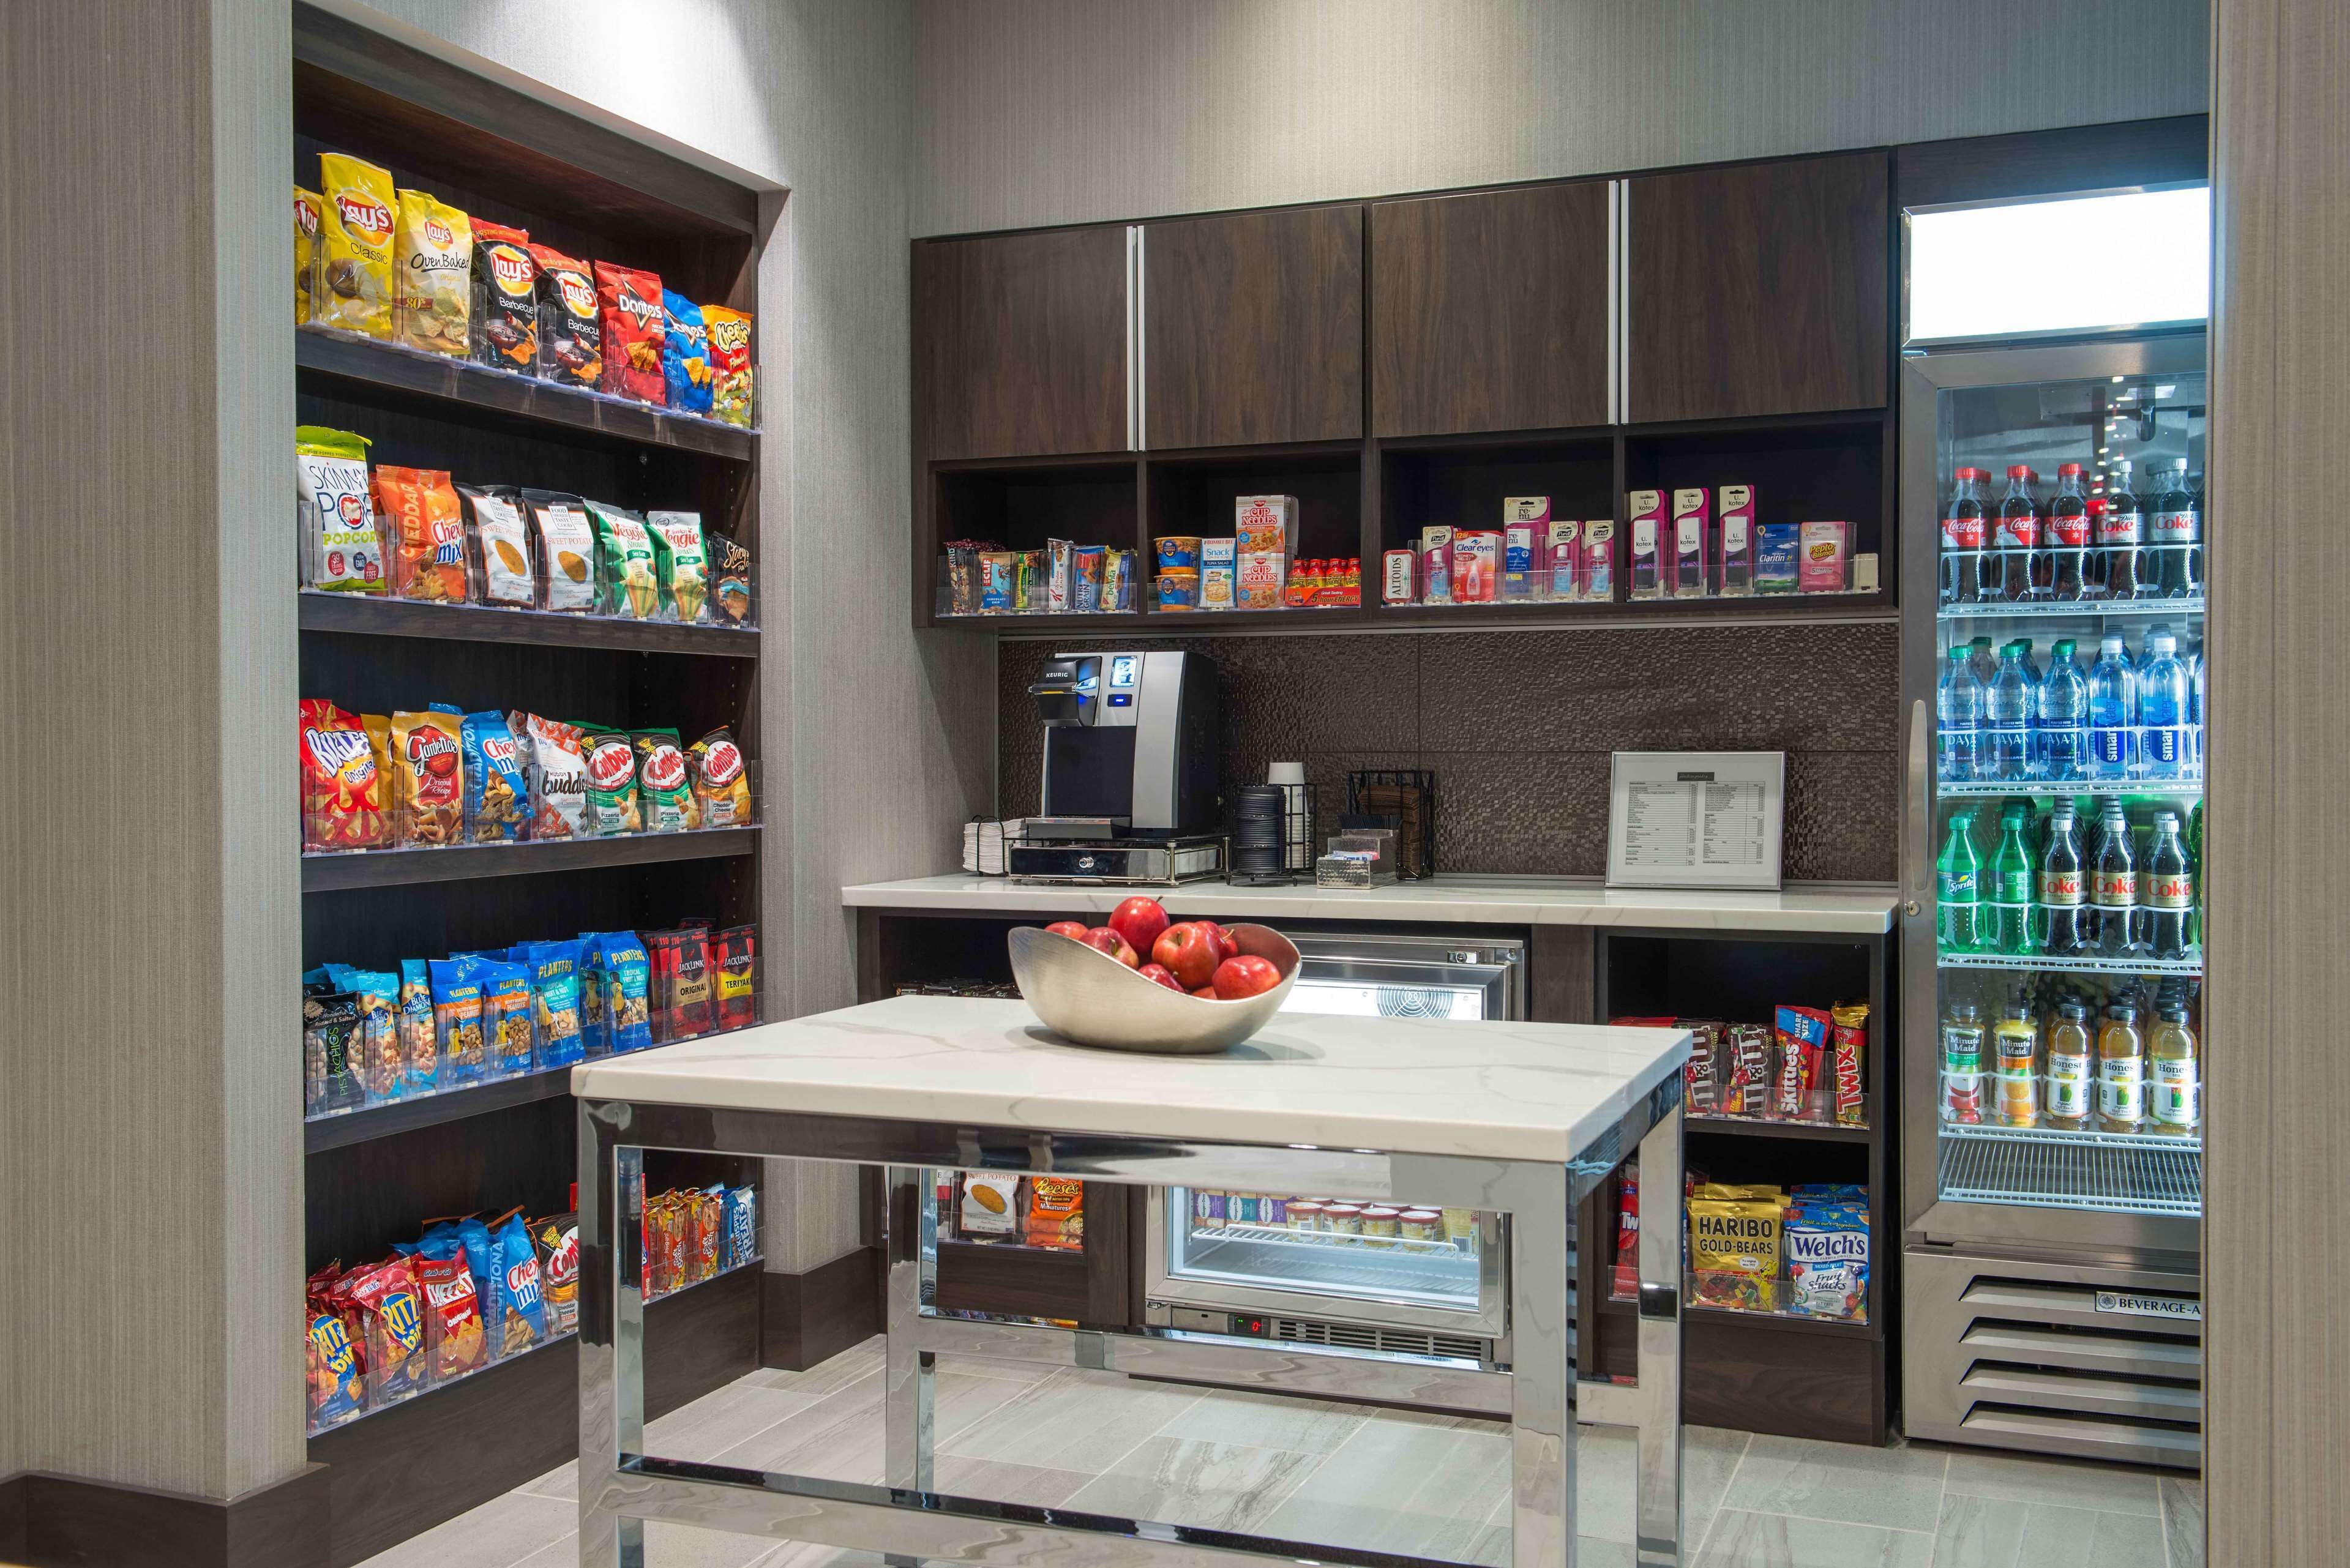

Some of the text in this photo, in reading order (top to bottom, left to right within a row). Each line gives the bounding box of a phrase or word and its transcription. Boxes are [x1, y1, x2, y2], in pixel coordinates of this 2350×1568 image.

[427, 221, 451, 242] Lay's
[351, 242, 387, 265] Classic
[492, 253, 532, 283] Lay's
[500, 297, 534, 315] Barbecue
[619, 294, 663, 319] Doritos
[716, 320, 749, 353] Cheetos
[1250, 508, 1270, 517] CUP
[1242, 515, 1278, 525] NOODLES
[1948, 519, 1985, 534] Coca-Cola
[2010, 518, 2041, 532] Coca-Cola
[2053, 517, 2091, 531] Coca-Cola
[2098, 518, 2133, 532] Coke
[2155, 515, 2193, 530] Coke
[432, 520, 462, 545] Chex
[610, 521, 648, 542] Veggie
[660, 529, 700, 548] Veggie
[436, 539, 462, 566] mix
[1207, 548, 1229, 556] Snack
[1810, 543, 1835, 553] Pepto-
[1813, 549, 1835, 559] Bismol
[366, 570, 376, 580] FREE
[1251, 566, 1271, 574] CUP
[1392, 558, 1401, 595] ALTOIDS
[1107, 570, 1116, 595] belVita
[1243, 573, 1278, 583] NOODLES
[1993, 734, 2032, 746] DASANI
[2042, 734, 2081, 746] DASANI
[406, 736, 459, 777] Gardetto's
[589, 747, 632, 780] Combos
[708, 744, 737, 778] Combos
[428, 775, 452, 787] Original
[432, 786, 452, 797] Recipe
[1950, 879, 1975, 892] Sprite
[2038, 877, 2081, 894] Coke
[2094, 879, 2136, 895] Coke
[2147, 880, 2191, 897] Coke
[659, 936, 668, 945] 110
[671, 936, 679, 945] 110
[611, 949, 645, 965] PLANTERS
[723, 957, 736, 967] JACK
[539, 960, 572, 979] PLANTERS
[678, 963, 690, 973] JACK
[500, 979, 525, 990] PLANTERS
[680, 982, 706, 996] ORIGINAL
[449, 987, 478, 998] PLANTERS
[411, 994, 427, 1006] BLUE
[371, 1010, 383, 1018] BLUE
[1950, 1036, 1980, 1044] Minute
[2051, 1058, 2081, 1069] Honest
[1781, 1043, 1800, 1114] Skittles
[1836, 1045, 1863, 1114] TWIX
[1035, 1178, 1079, 1194] Reese's
[1040, 1203, 1069, 1211] Miniatures
[733, 1206, 743, 1242] KRISPIES
[738, 1203, 754, 1259] TREATS
[1699, 1217, 1773, 1238] HARIBO
[549, 1234, 561, 1247] CHEESE
[1700, 1238, 1773, 1254] GOLD-BEARS
[1793, 1235, 1865, 1256] Welch's
[424, 1269, 438, 1277] Grab
[507, 1256, 539, 1290] Chex
[334, 1283, 344, 1293] BIG
[366, 1281, 380, 1293] BAG
[1807, 1280, 1847, 1291] Snacks
[380, 1295, 419, 1335] RITZ
[309, 1318, 350, 1357] RITZ
